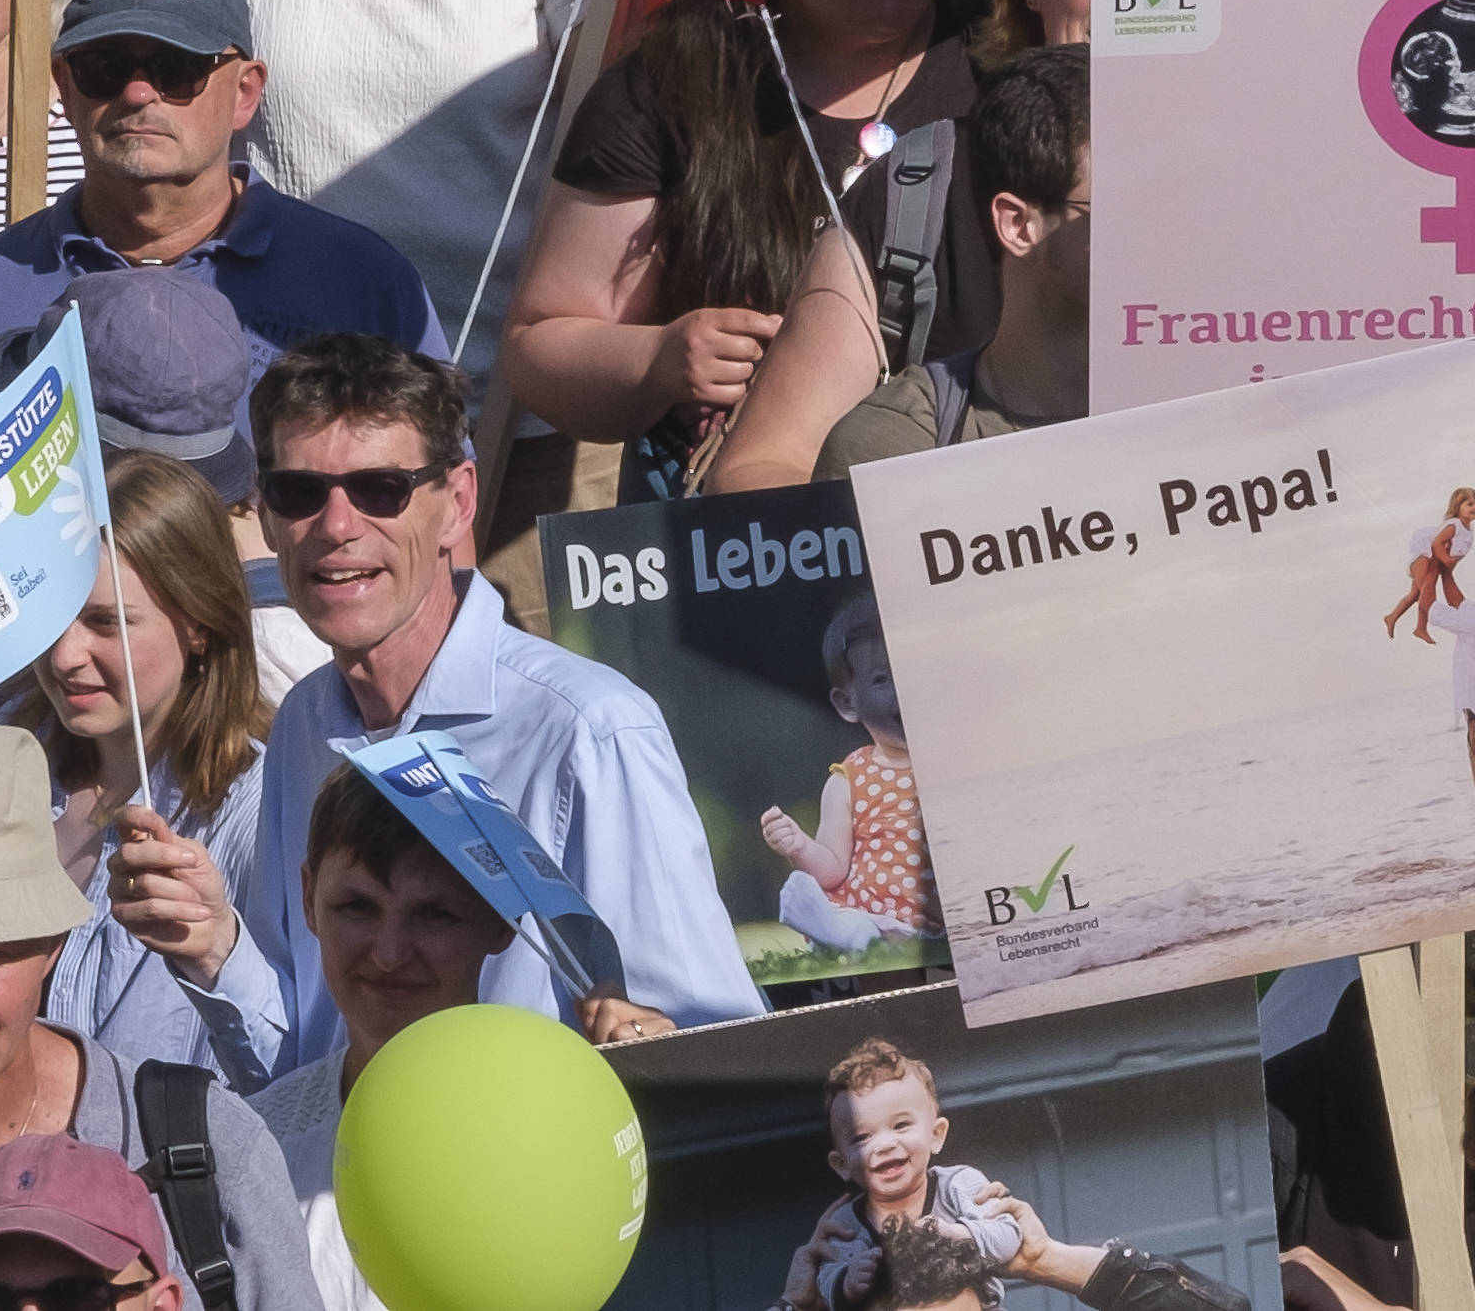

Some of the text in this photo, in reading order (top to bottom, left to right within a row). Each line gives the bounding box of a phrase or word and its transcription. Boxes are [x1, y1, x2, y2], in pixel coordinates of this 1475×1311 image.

[920, 449, 1339, 587] Danke, Papa!
[566, 520, 867, 612] Das Leben
[996, 917, 1099, 950] Bundesverband
[999, 937, 1082, 964] Lebensrecht
